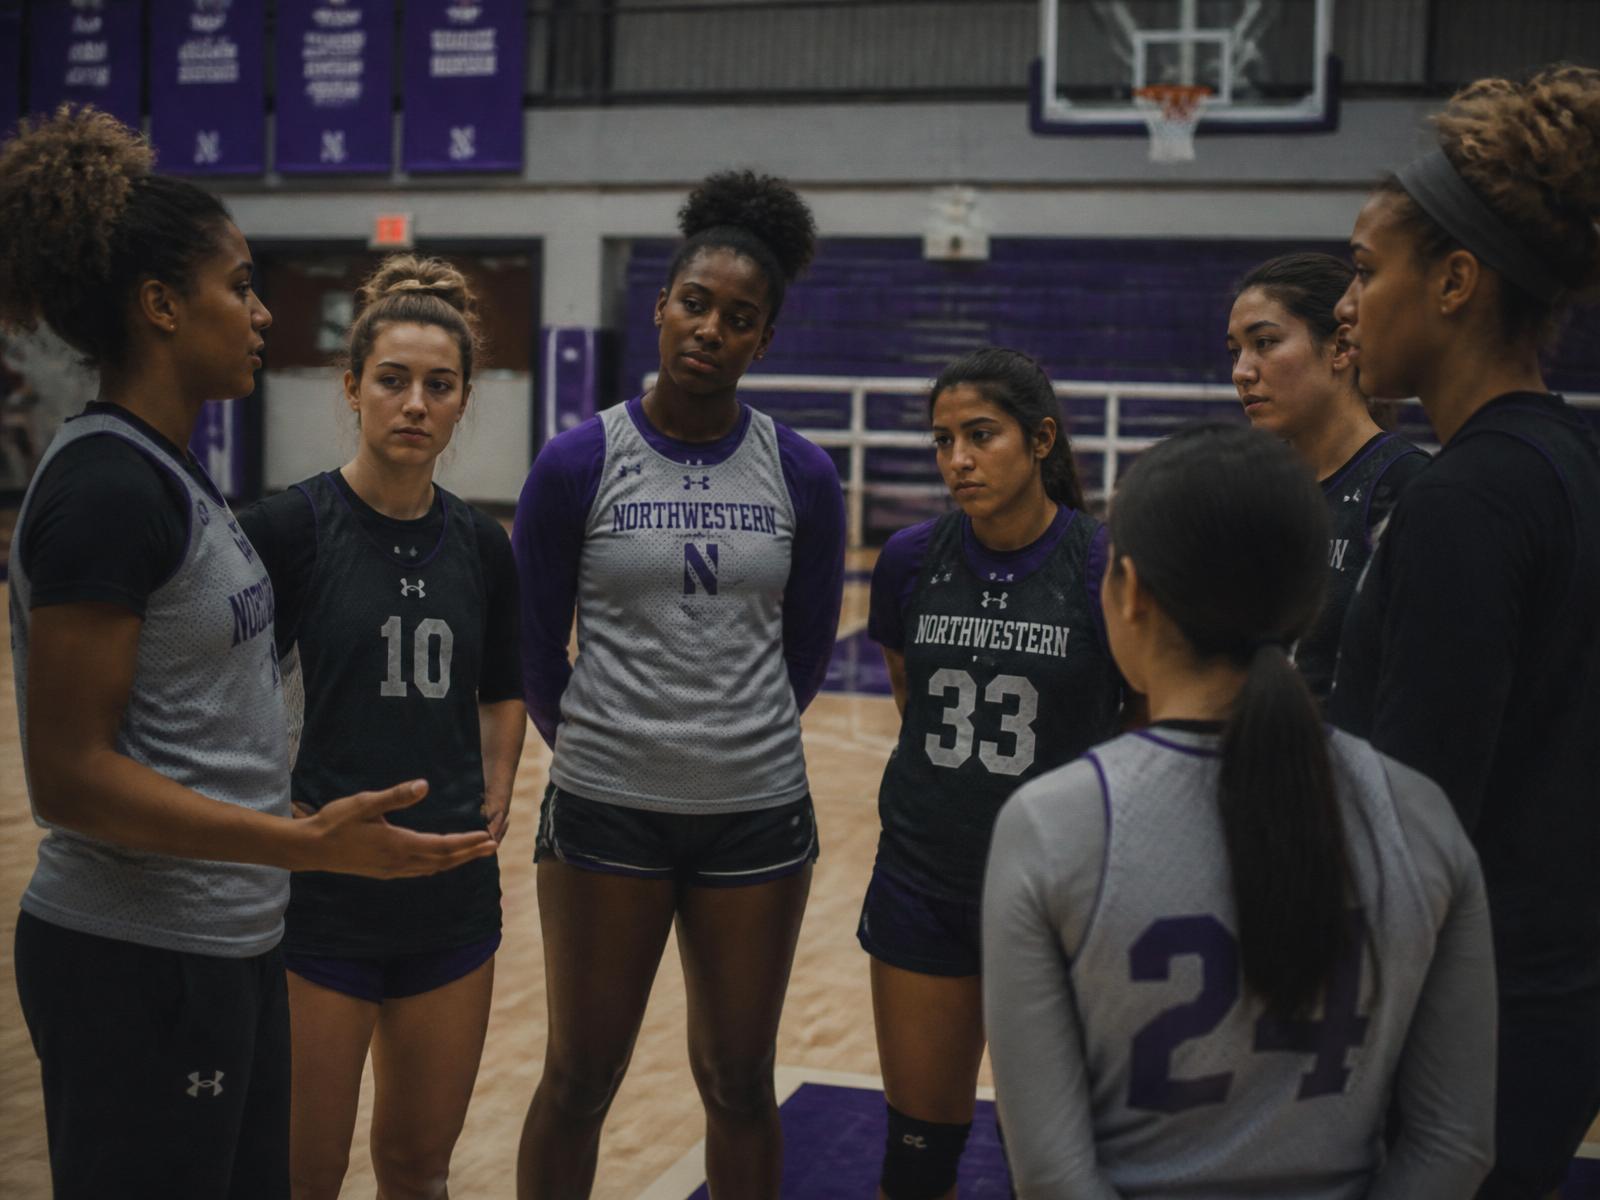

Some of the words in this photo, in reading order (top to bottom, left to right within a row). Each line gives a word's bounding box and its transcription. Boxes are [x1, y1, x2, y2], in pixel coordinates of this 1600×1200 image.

[611, 501, 777, 535] NORTHWESTERN
[683, 542, 719, 596] N
[380, 615, 454, 699] 10
[914, 614, 1070, 658] NORTHWESTERN
[924, 667, 1039, 776] 33
[1125, 907, 1370, 1114] 24
